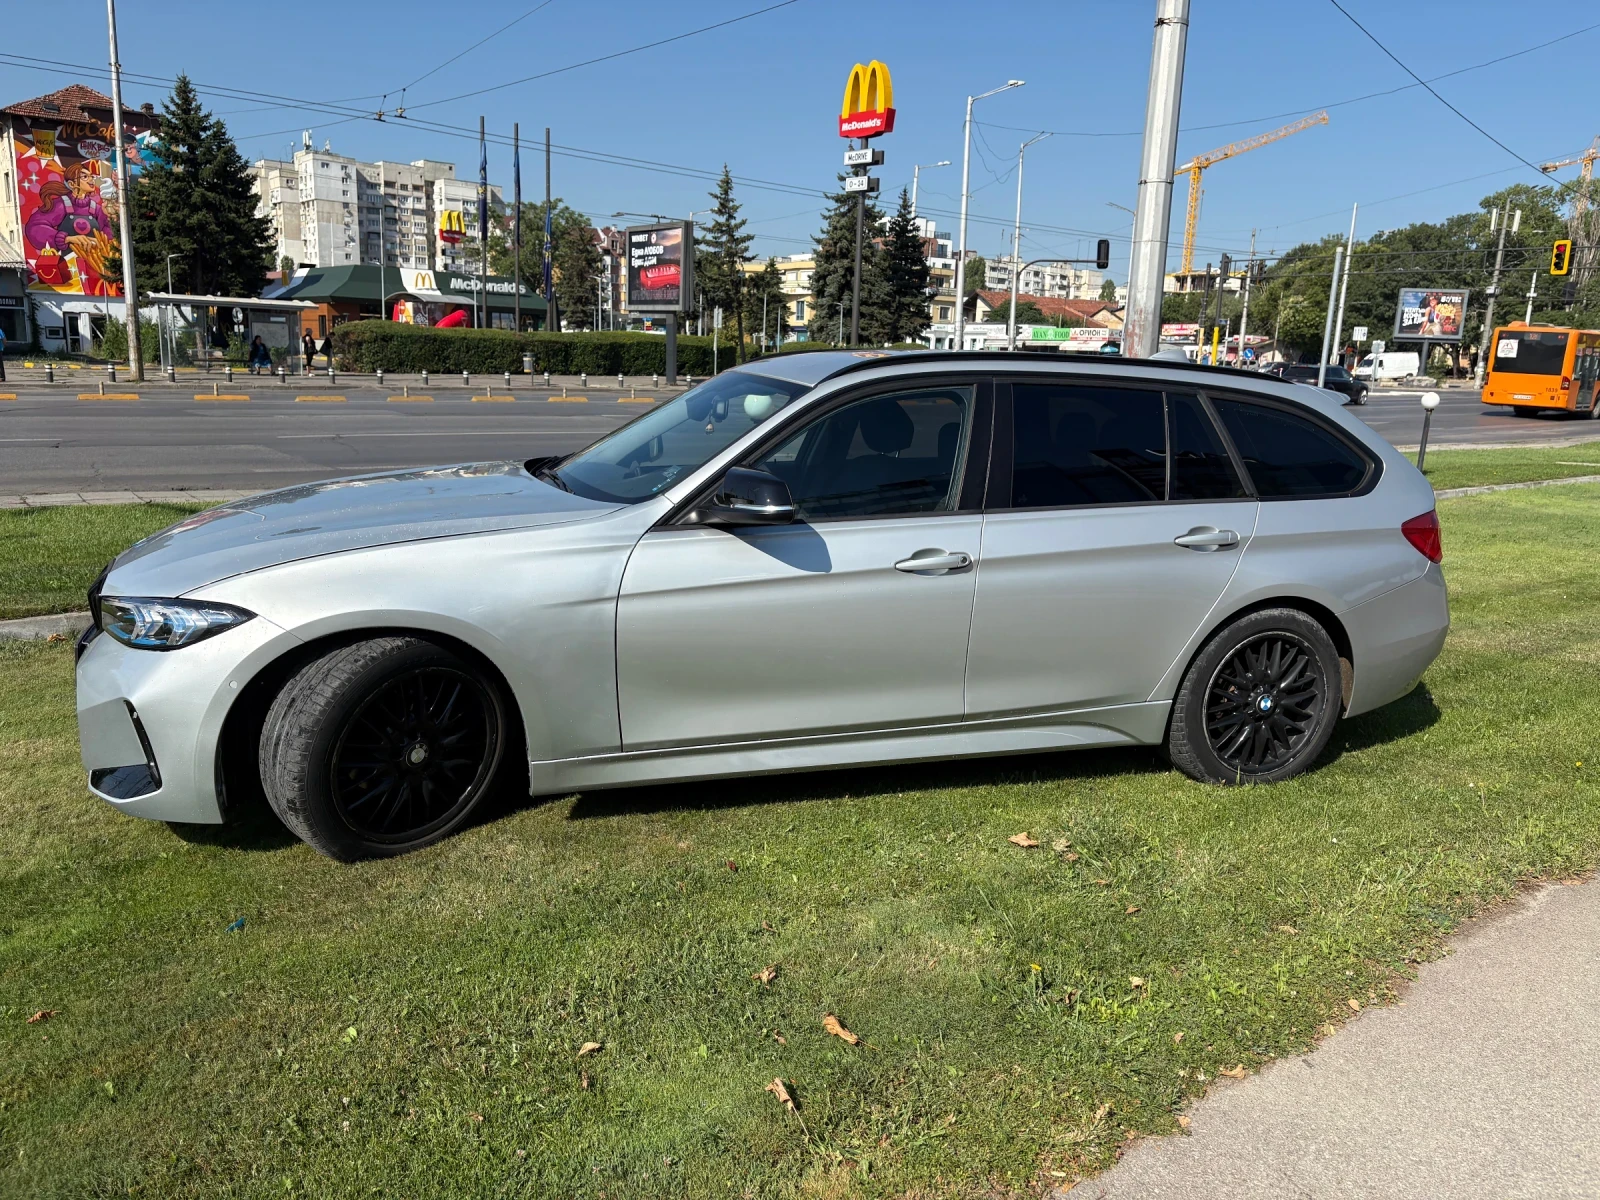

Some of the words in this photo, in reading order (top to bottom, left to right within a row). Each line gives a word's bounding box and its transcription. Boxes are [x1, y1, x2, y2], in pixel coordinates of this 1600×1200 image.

[841, 118, 882, 132] McDonald's
[848, 152, 868, 162] McDRIVE
[450, 277, 526, 294] McDonalds
[1032, 331, 1047, 339] AYAN
[1054, 330, 1070, 339] FOOD
